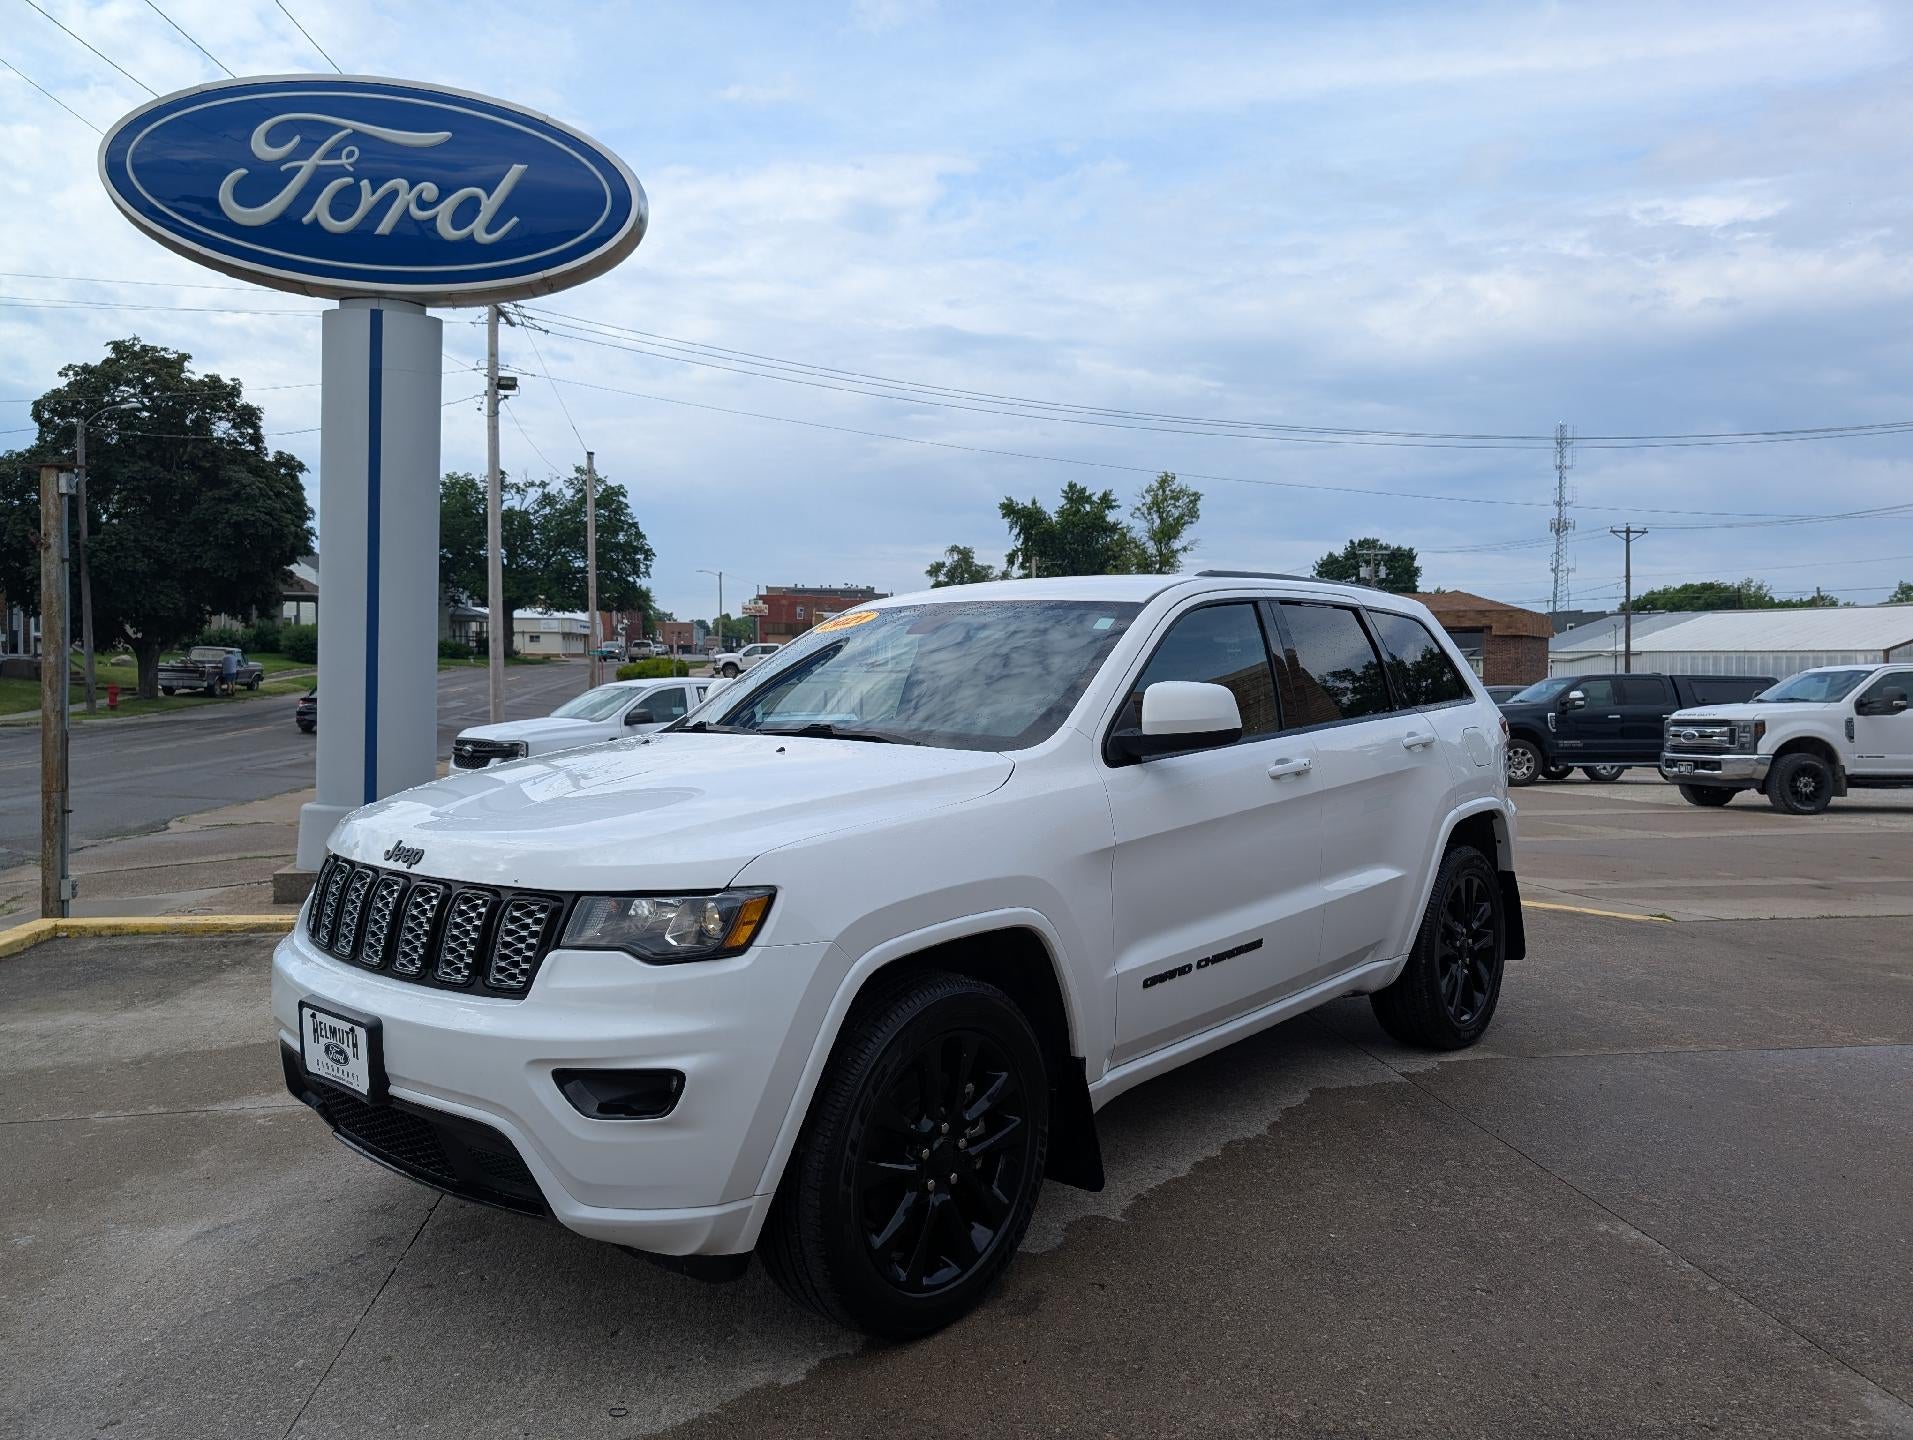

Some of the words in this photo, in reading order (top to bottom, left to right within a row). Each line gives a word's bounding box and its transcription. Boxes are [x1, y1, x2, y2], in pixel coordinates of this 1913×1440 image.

[219, 112, 528, 245] Ford
[383, 839, 425, 870] Jeep
[1142, 963, 1193, 989] GRAND
[1196, 937, 1264, 970] CHEROKEE
[311, 1017, 360, 1061] HELMUTH
